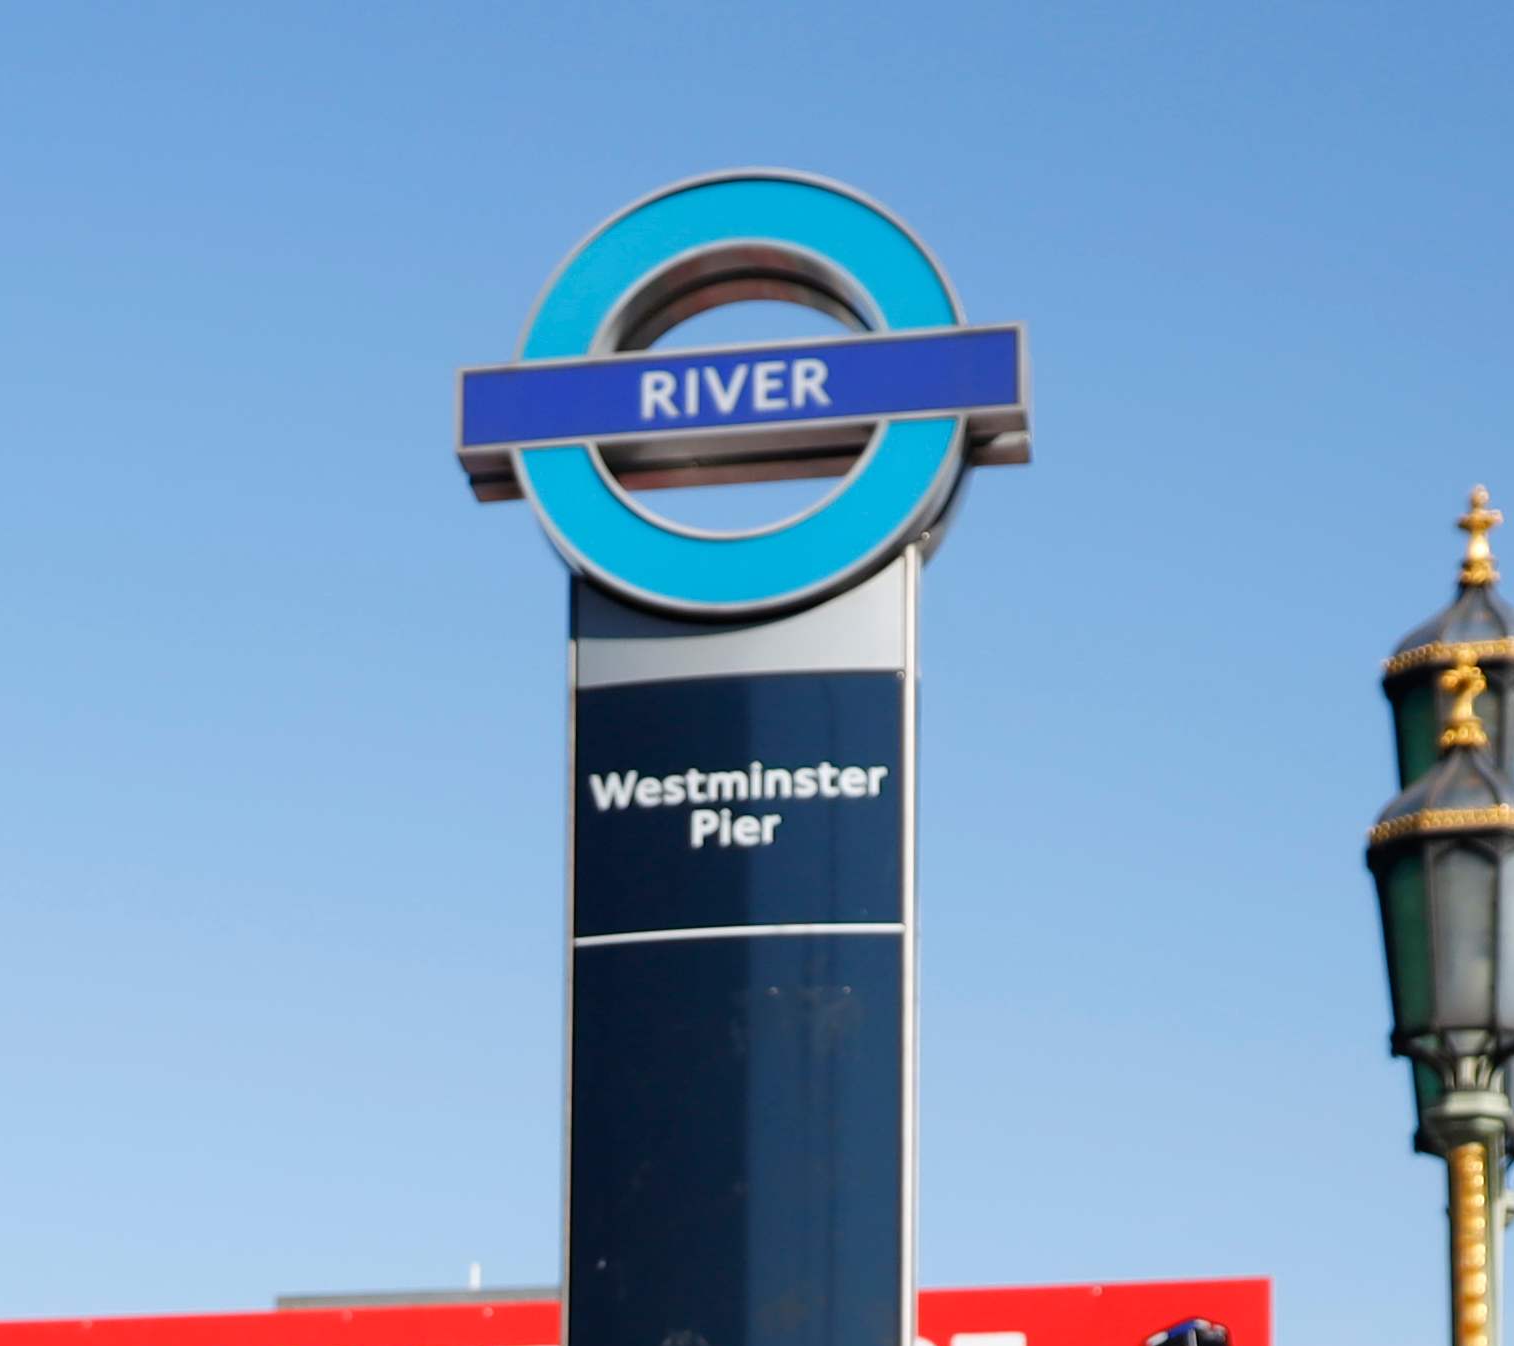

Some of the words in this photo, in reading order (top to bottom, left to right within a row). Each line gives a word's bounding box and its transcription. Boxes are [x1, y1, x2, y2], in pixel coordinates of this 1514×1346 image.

[640, 357, 833, 421] RIVER
[588, 760, 889, 812] Westminster
[690, 807, 783, 849] Pier
